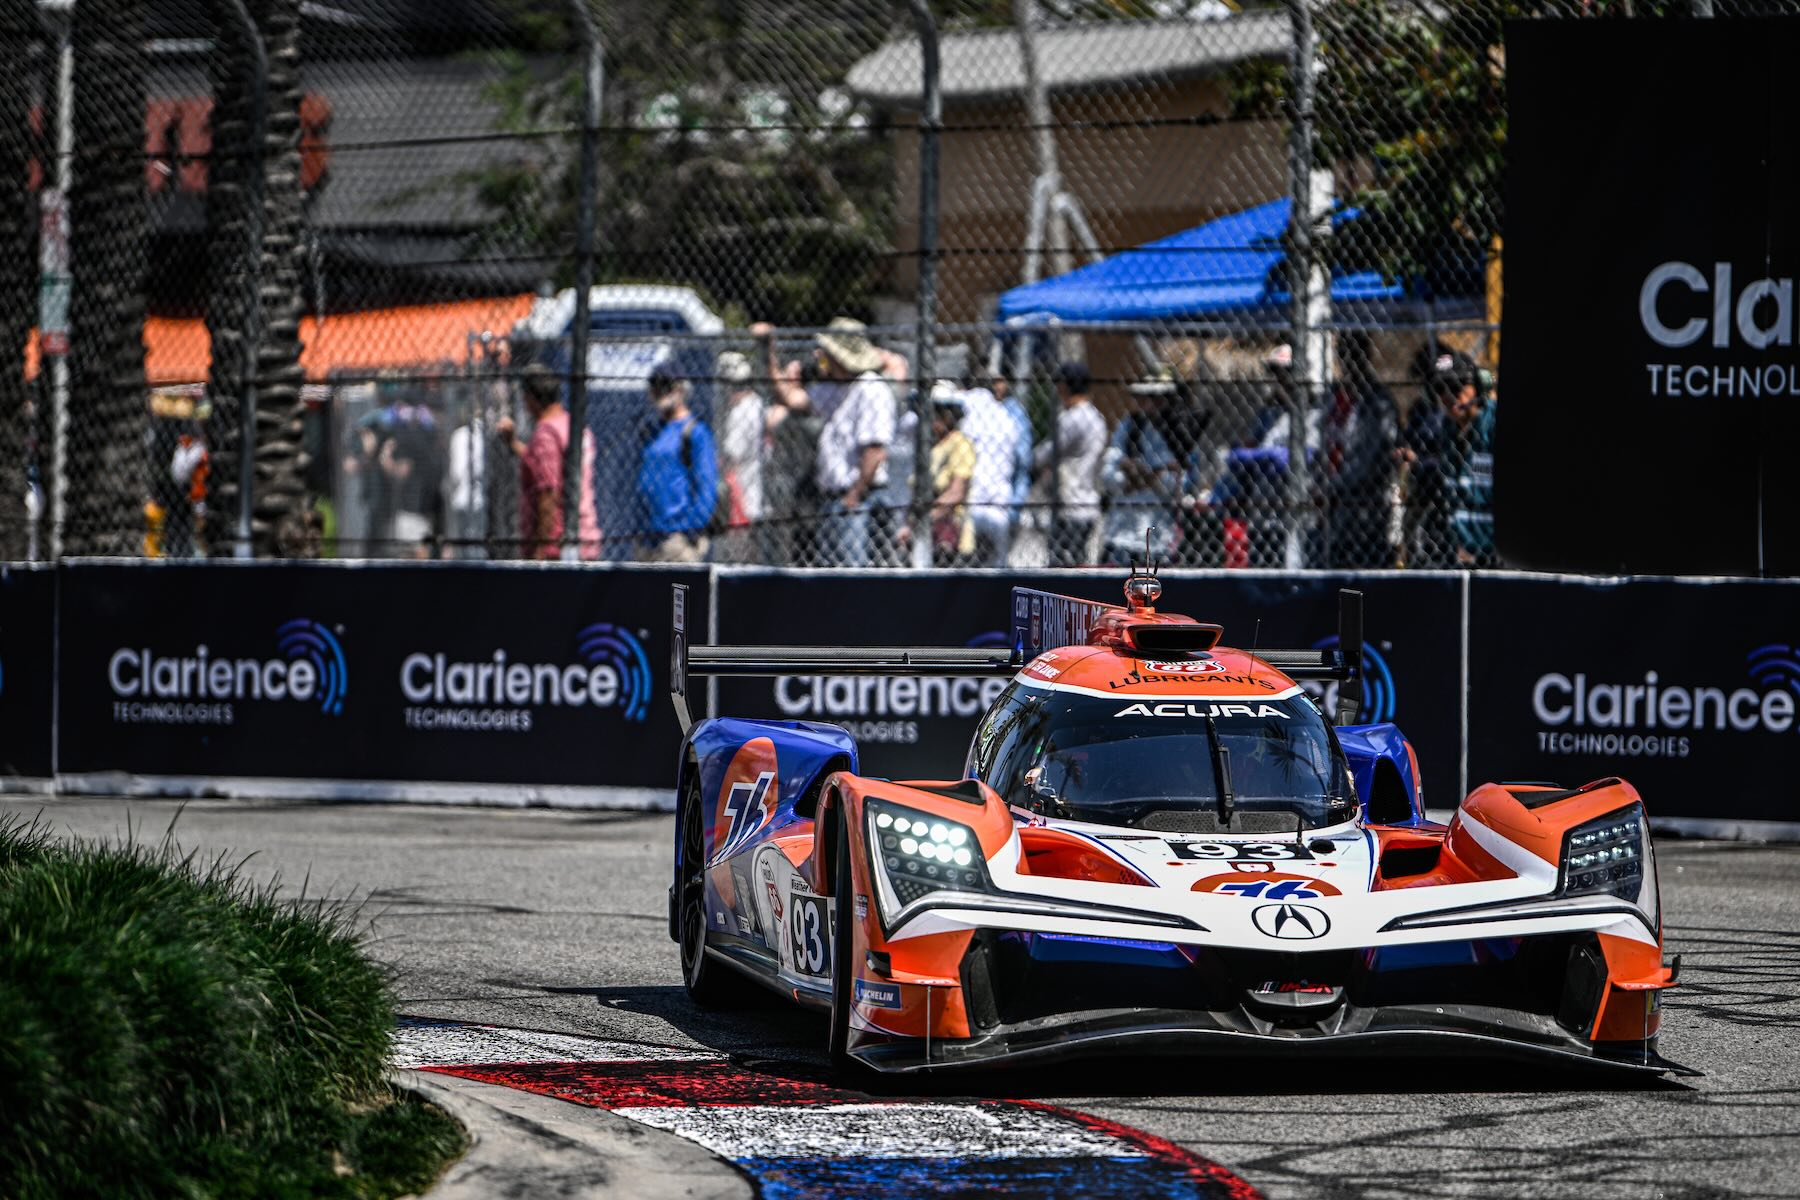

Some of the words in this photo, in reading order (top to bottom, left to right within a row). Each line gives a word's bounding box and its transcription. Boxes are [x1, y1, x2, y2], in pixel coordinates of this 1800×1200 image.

[1639, 261, 1800, 349] Cla
[1646, 364, 1800, 398] TECHNOL
[1042, 595, 1069, 652] BRING
[1070, 601, 1088, 646] THE
[108, 644, 316, 700] Clarience
[400, 648, 617, 706] Clarience
[1109, 672, 1276, 690] LUBRICANTS
[112, 702, 234, 724] TECHNOLOGIES
[1113, 703, 1291, 719] ACURA
[1532, 670, 1794, 733] Clarience
[404, 707, 533, 732] TECHNOLOGIES
[1537, 731, 1690, 757] TECHNOLOGIES
[1186, 843, 1296, 859] 93
[793, 898, 823, 973] 93
